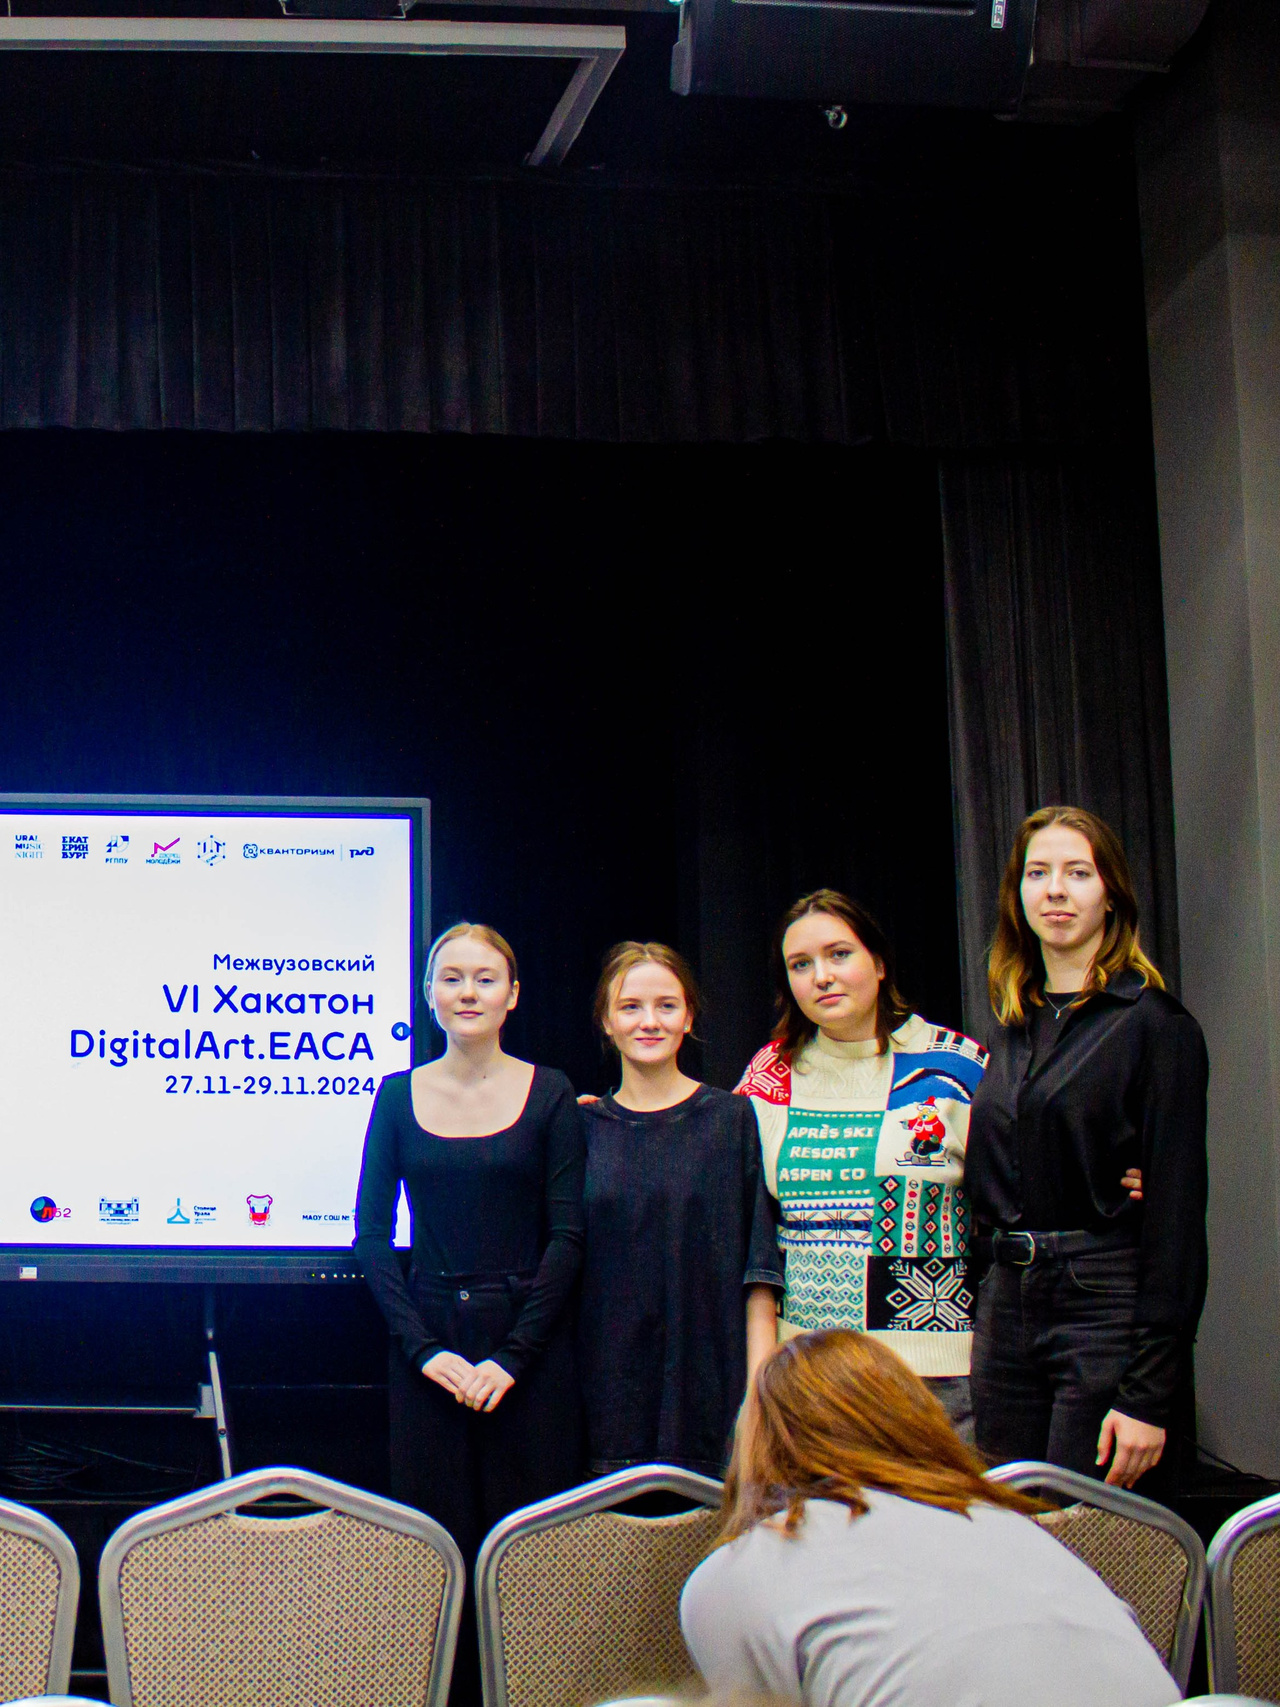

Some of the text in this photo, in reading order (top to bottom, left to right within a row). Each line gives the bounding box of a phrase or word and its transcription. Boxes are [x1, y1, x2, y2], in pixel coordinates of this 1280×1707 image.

[61, 836, 89, 844] ЕКАТ
[61, 851, 89, 859] БУРГ
[213, 954, 375, 975] Межвузовский
[162, 984, 374, 1014] VI Хакатон
[70, 1029, 374, 1067] DigitalArt.EACA
[165, 1075, 376, 1095] 27.11-29.11.2024
[788, 1124, 874, 1139] APRÈS SKI
[790, 1146, 859, 1159] RESORT
[779, 1168, 866, 1182] ASPEN CO
